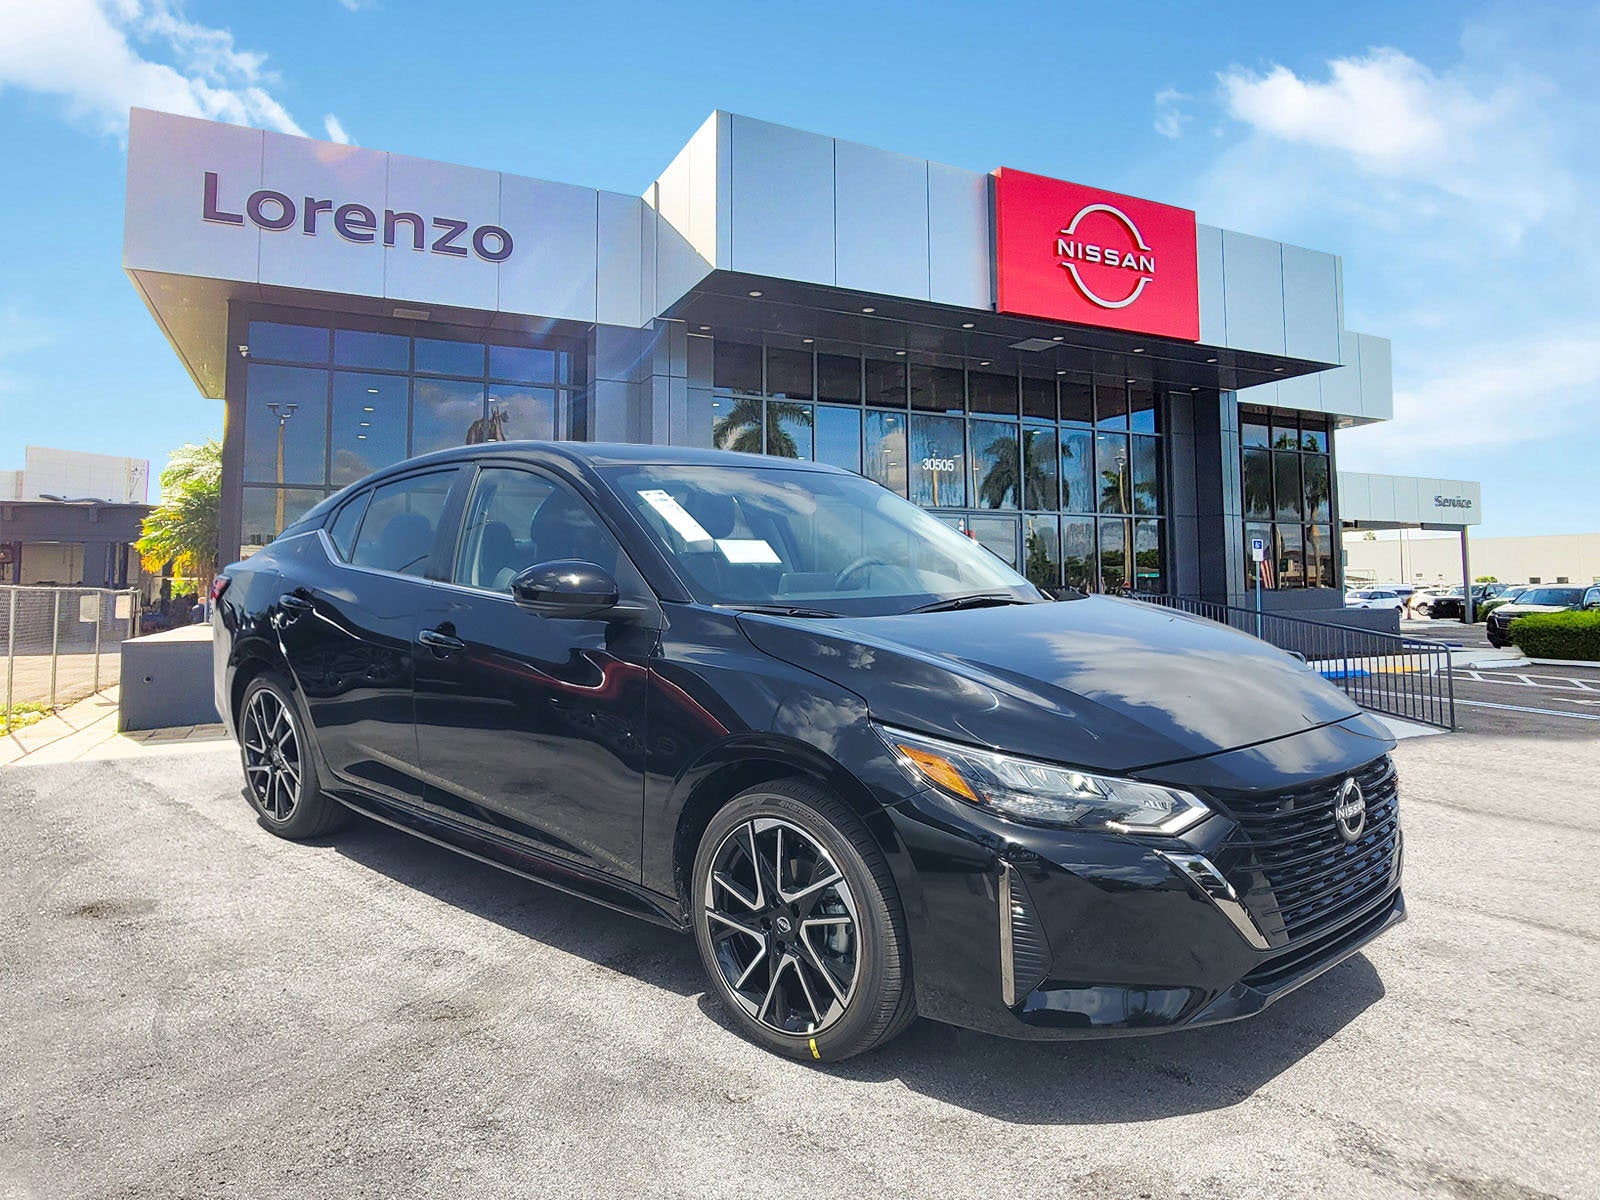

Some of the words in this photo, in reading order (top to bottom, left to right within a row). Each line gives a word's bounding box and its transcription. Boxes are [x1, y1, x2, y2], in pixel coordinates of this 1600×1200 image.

[202, 171, 514, 262] Lorenzo
[1057, 238, 1155, 273] NISSAN
[922, 458, 955, 471] 30505
[1434, 495, 1472, 509] Service
